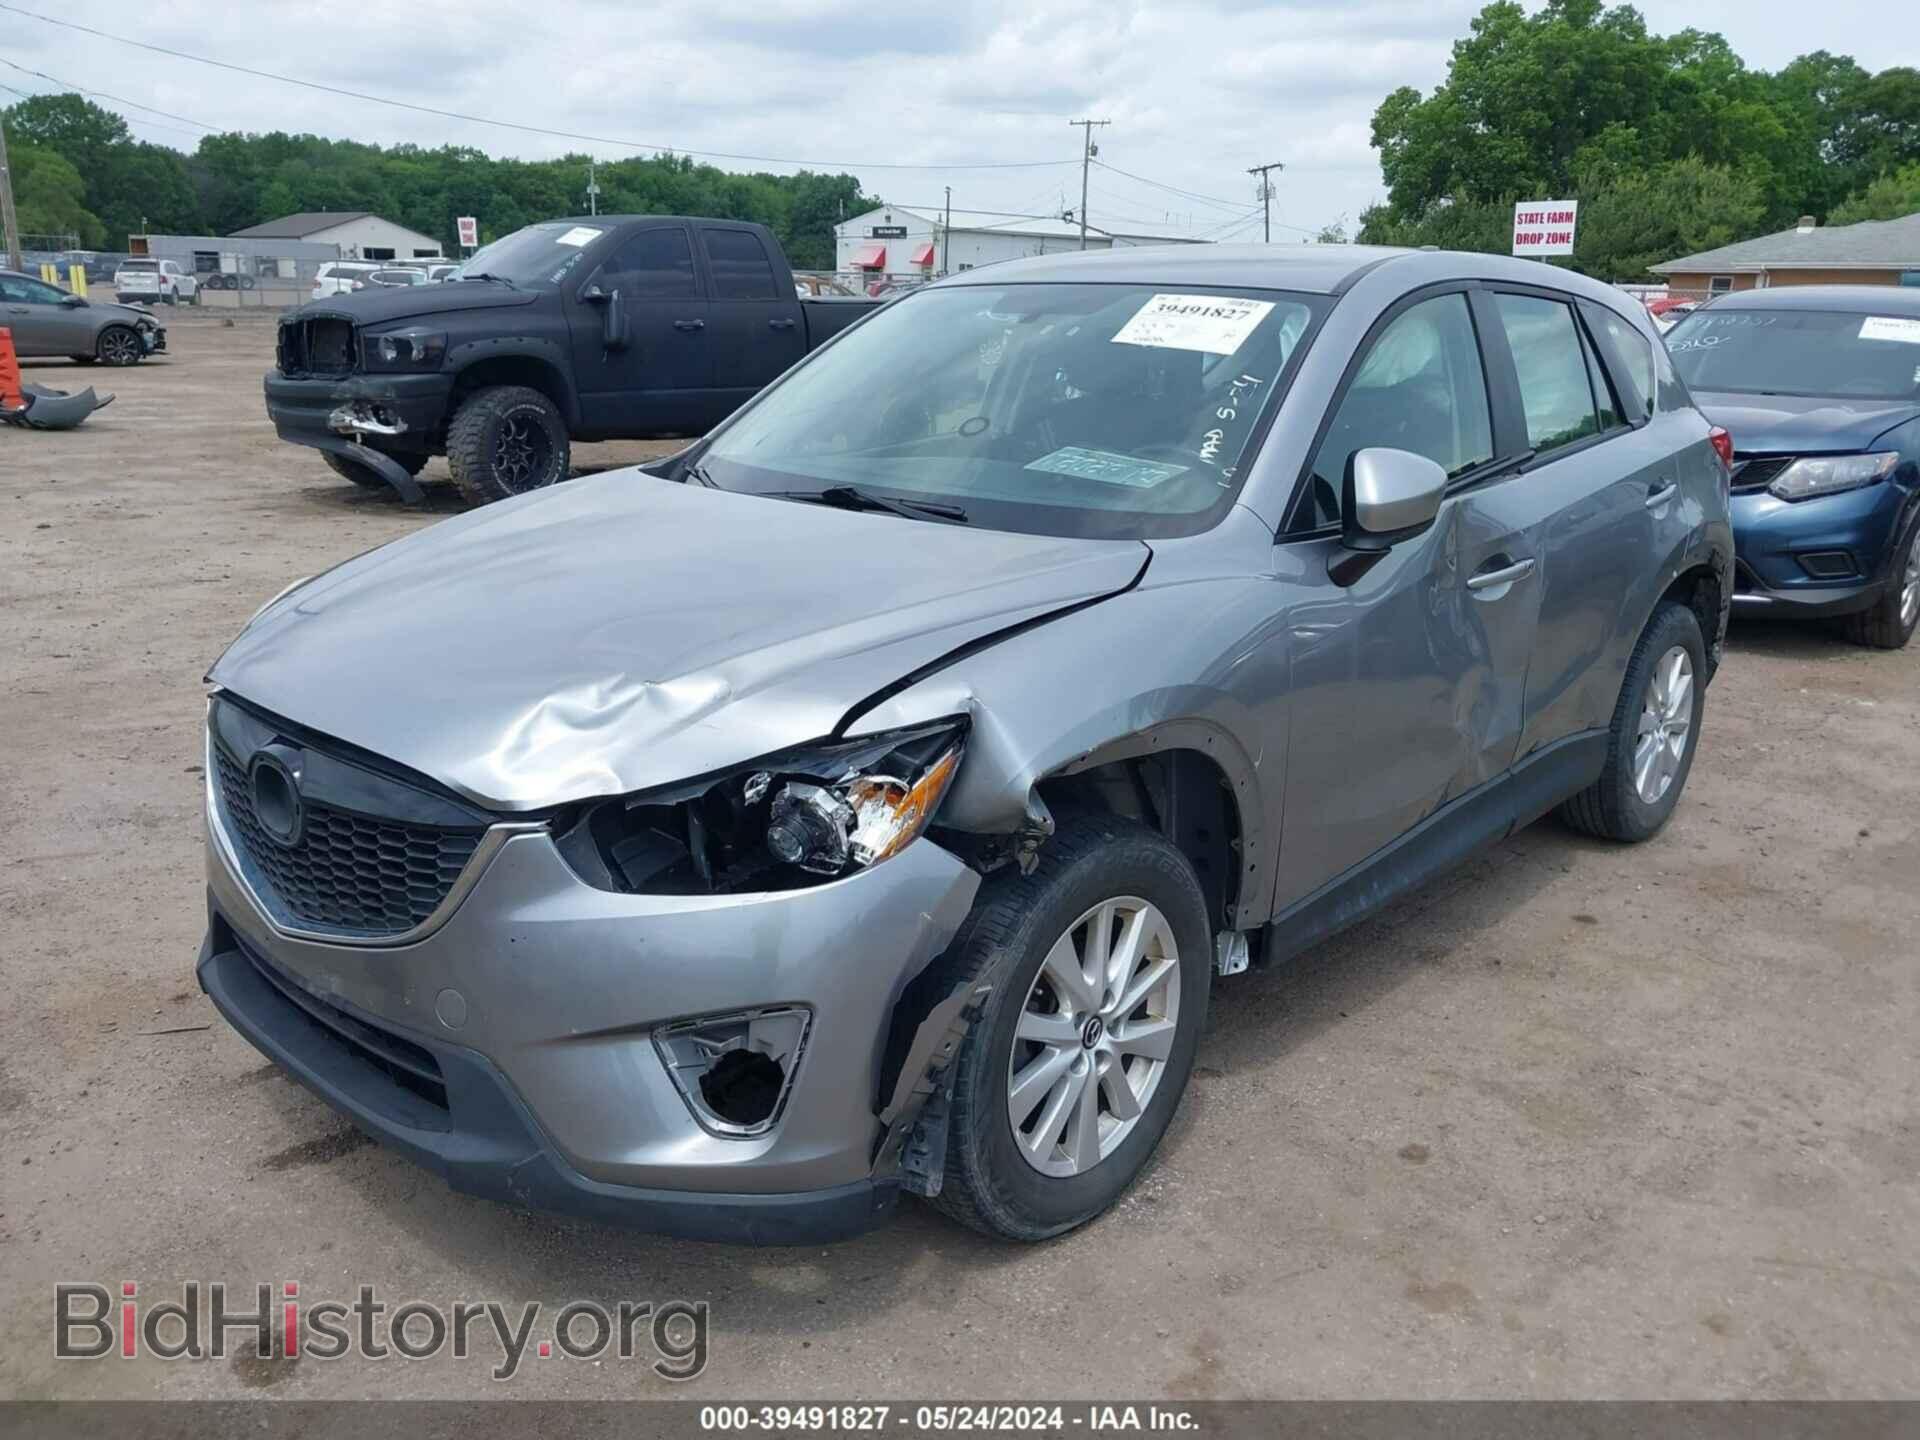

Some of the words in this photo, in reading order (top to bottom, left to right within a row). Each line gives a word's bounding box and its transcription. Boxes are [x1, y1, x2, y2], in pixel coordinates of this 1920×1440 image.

[1517, 213, 1545, 225] STATE
[1547, 211, 1574, 224] FARM
[1516, 233, 1543, 245] DROP
[1545, 232, 1571, 245] ZONE
[1155, 303, 1251, 321] 39491827
